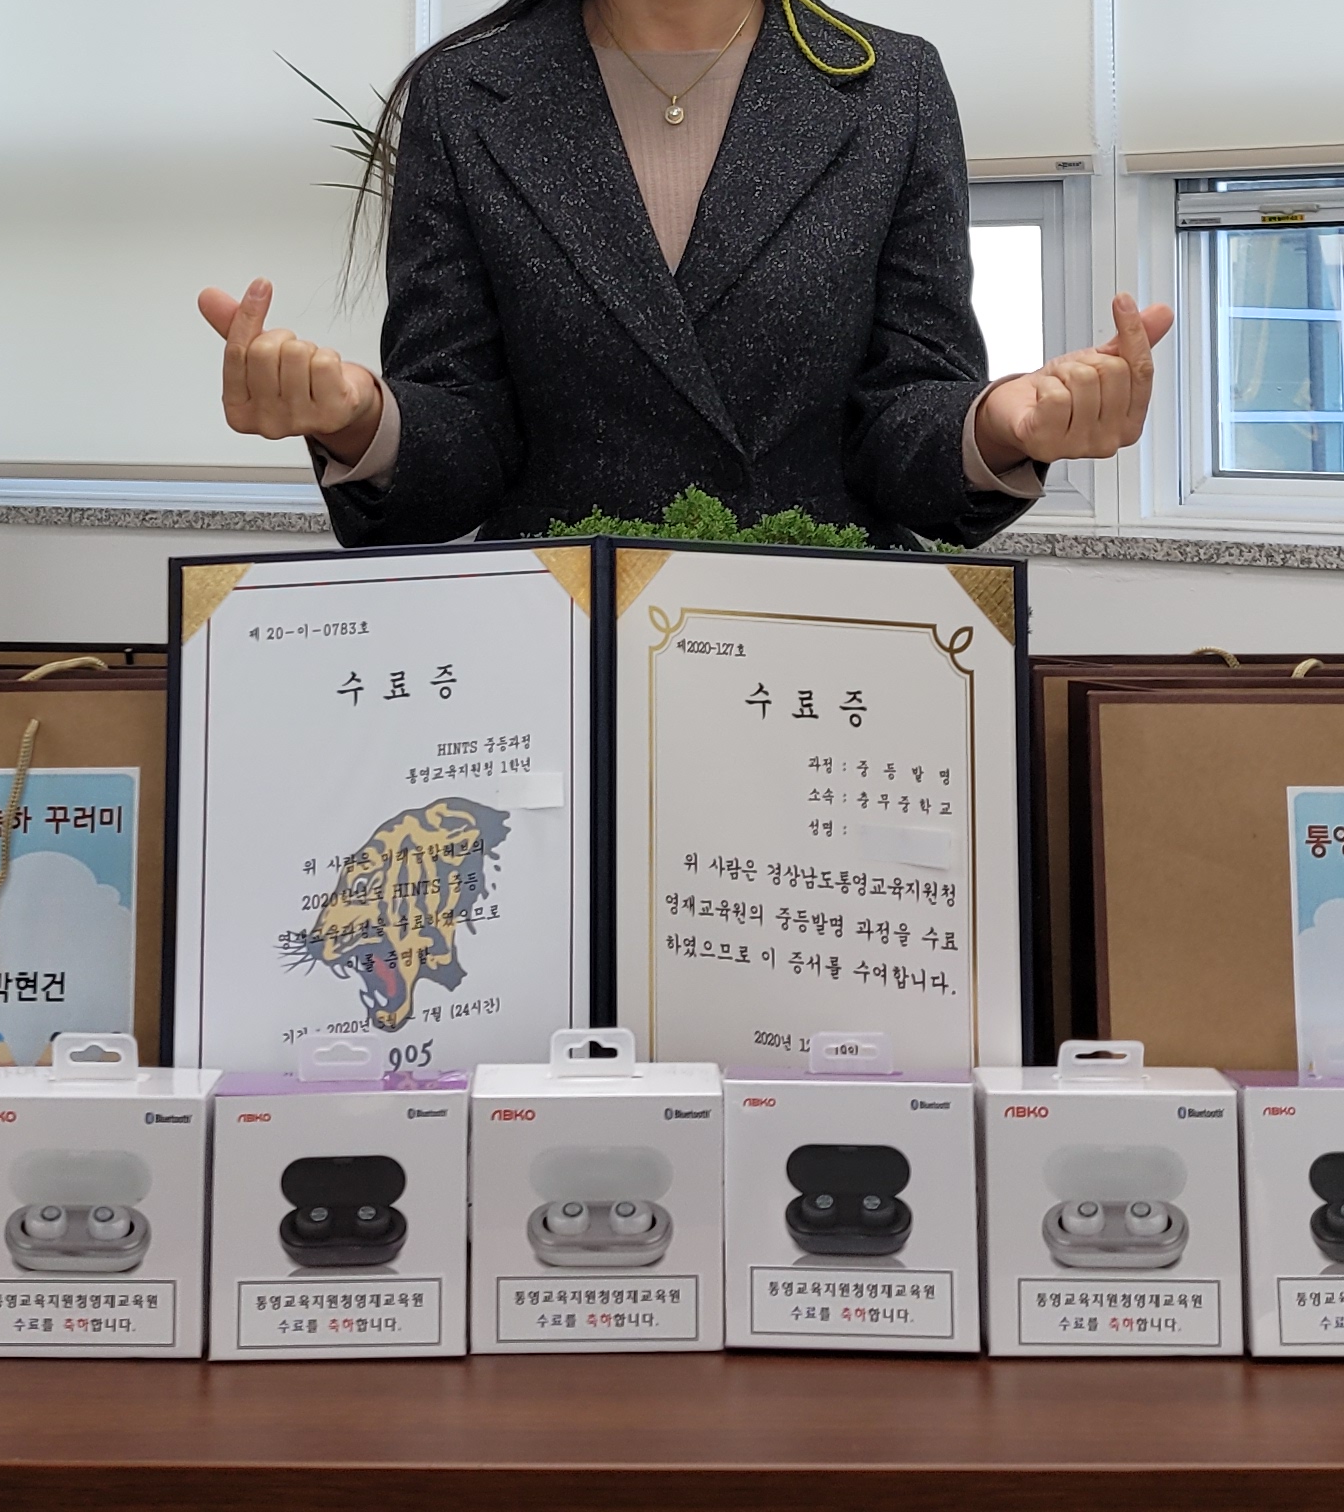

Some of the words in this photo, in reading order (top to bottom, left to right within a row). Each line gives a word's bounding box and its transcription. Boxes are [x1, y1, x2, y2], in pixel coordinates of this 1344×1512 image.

[249, 627, 259, 641] 제
[437, 741, 477, 756] HINTS
[484, 734, 530, 753] 중등과정
[406, 761, 493, 784] 통영교육지원청
[501, 757, 530, 773] 1학년
[44, 805, 124, 835] 꾸러미
[303, 859, 316, 876] 위
[327, 853, 372, 872] 사람은
[381, 839, 484, 864] 미래융합허브의
[684, 853, 697, 873] 위
[709, 856, 757, 881] 사람은
[768, 863, 955, 907] 경상남도통영교육지원청
[302, 889, 384, 910] 2020학년도
[393, 879, 441, 899] HINTS
[449, 873, 478, 892] 중등
[279, 917, 386, 950] 영재교육과정을
[393, 904, 500, 931] 수료하였으므로
[666, 893, 763, 926] 영재교육원의
[776, 908, 843, 938] 중등발명
[856, 919, 910, 947] 과정을
[922, 927, 958, 951] 수료
[346, 954, 375, 972] 이를
[666, 934, 750, 963] 하였으므로
[762, 947, 775, 969] 이
[788, 952, 842, 980] 증서를
[853, 961, 956, 995] 수여합니다.
[423, 1006, 442, 1023] 7월
[451, 998, 500, 1019] (24시간)
[754, 1031, 791, 1051] 2020년
[742, 1097, 777, 1108] ABKO
[1003, 1105, 1049, 1119] ABKO
[1262, 1106, 1297, 1117] ABKO
[237, 1112, 272, 1123] ABKO
[490, 1109, 536, 1122] ABKO
[514, 1288, 681, 1306] 통영교육지원청영재교육원
[768, 1281, 935, 1300] 통영교육지원청영재교육원
[255, 1292, 424, 1311] 통영교육지원청영재교육원
[1035, 1292, 1203, 1309] 통영교육지원청영재교육원
[536, 1313, 578, 1329] 수료를
[586, 1312, 661, 1328] 축하합니다.
[790, 1305, 832, 1322] 수료를
[840, 1306, 915, 1324] 축하합니다.
[13, 1317, 55, 1333] 수료를
[63, 1317, 137, 1333] 축하합니다.
[277, 1318, 319, 1334] 수료를
[328, 1317, 403, 1333] 축하합니다.
[1058, 1316, 1100, 1332] 수료를
[1108, 1316, 1183, 1333] 축하합니다.
